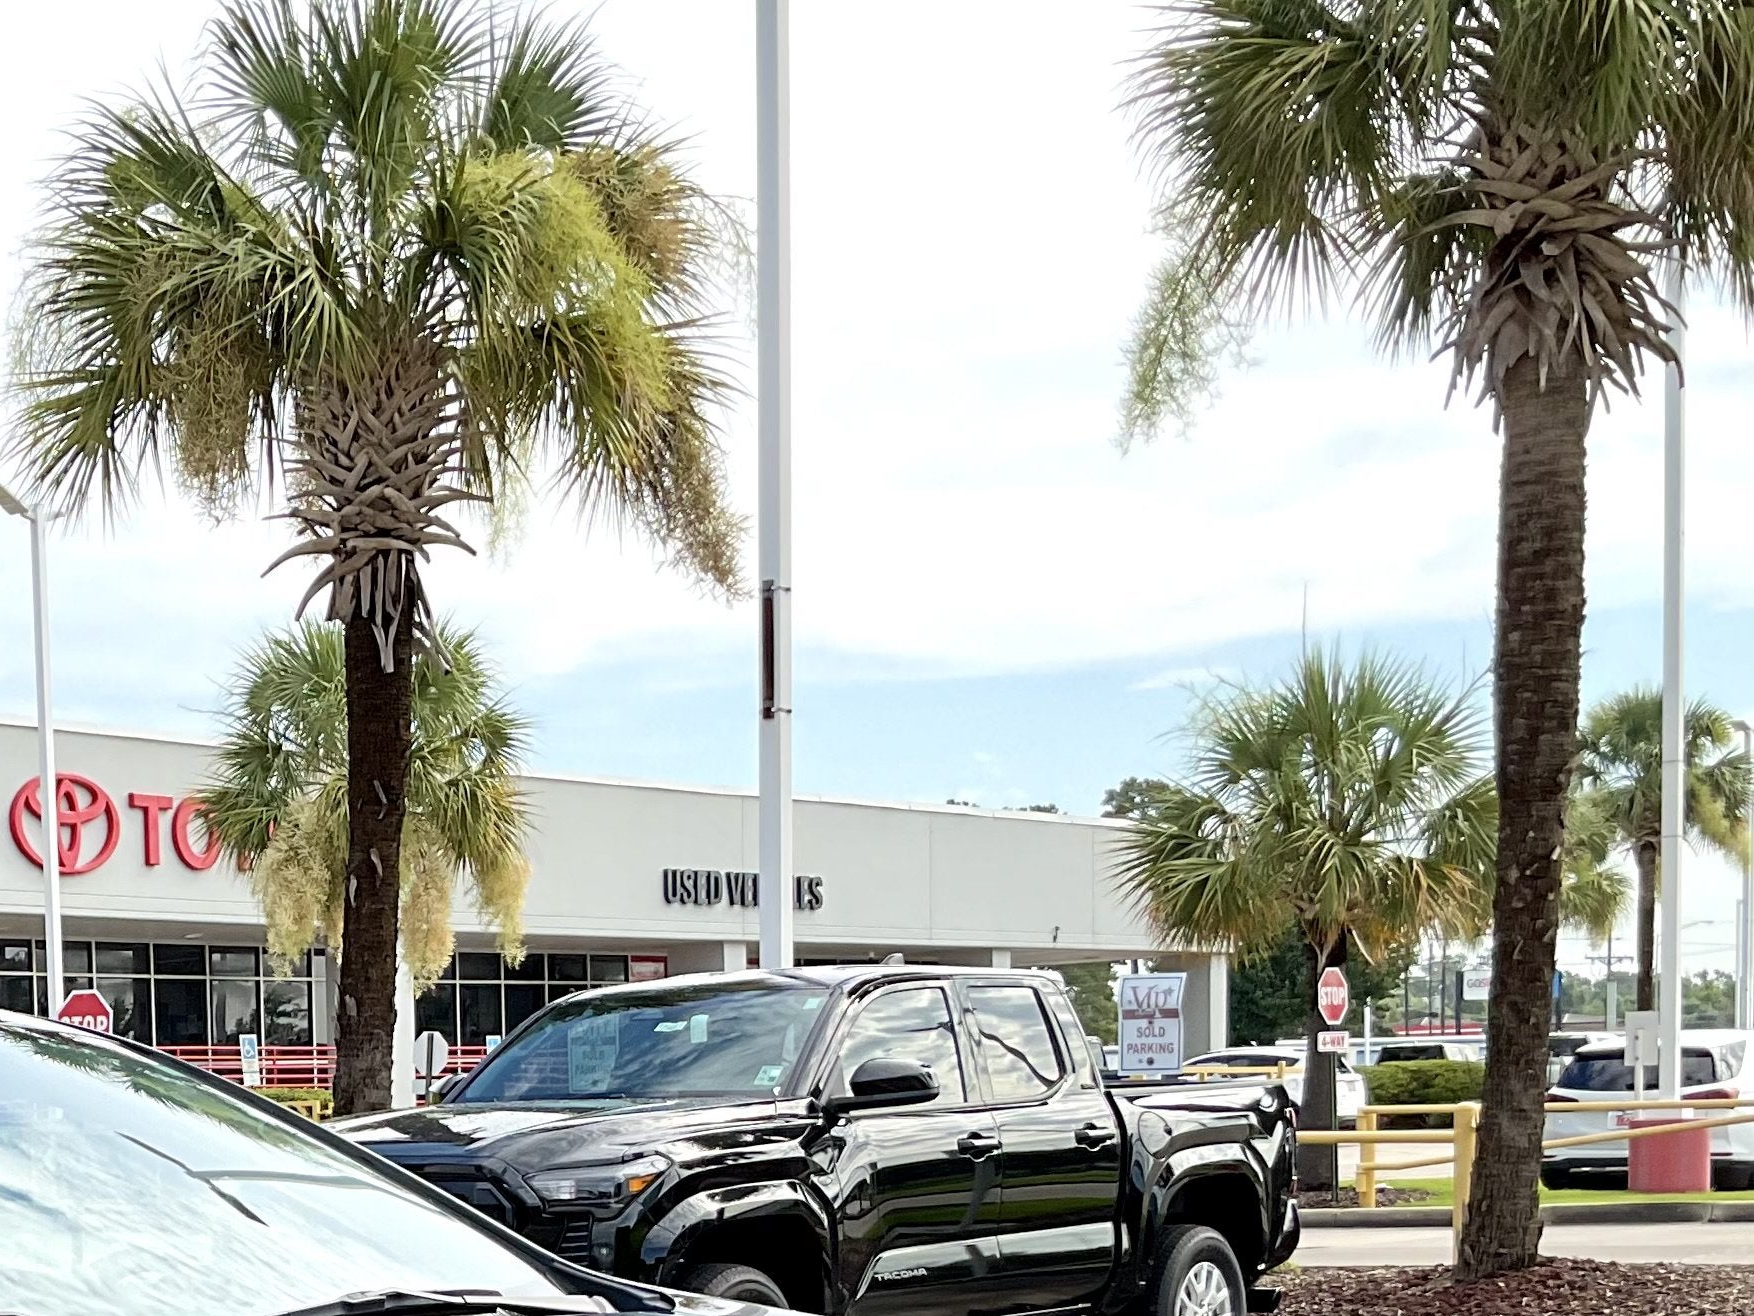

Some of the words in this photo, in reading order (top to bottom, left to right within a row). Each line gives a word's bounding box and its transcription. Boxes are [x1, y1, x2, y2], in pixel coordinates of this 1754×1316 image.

[663, 868, 723, 905] USED
[725, 871, 823, 911] VELES
[1321, 986, 1345, 1006] STOP
[60, 1015, 109, 1032] OP
[1136, 1026, 1166, 1039] SOLD
[1126, 1042, 1175, 1055] PARKING
[1321, 1034, 1345, 1049] 4-WAY
[873, 1267, 928, 1282] TACOMA
